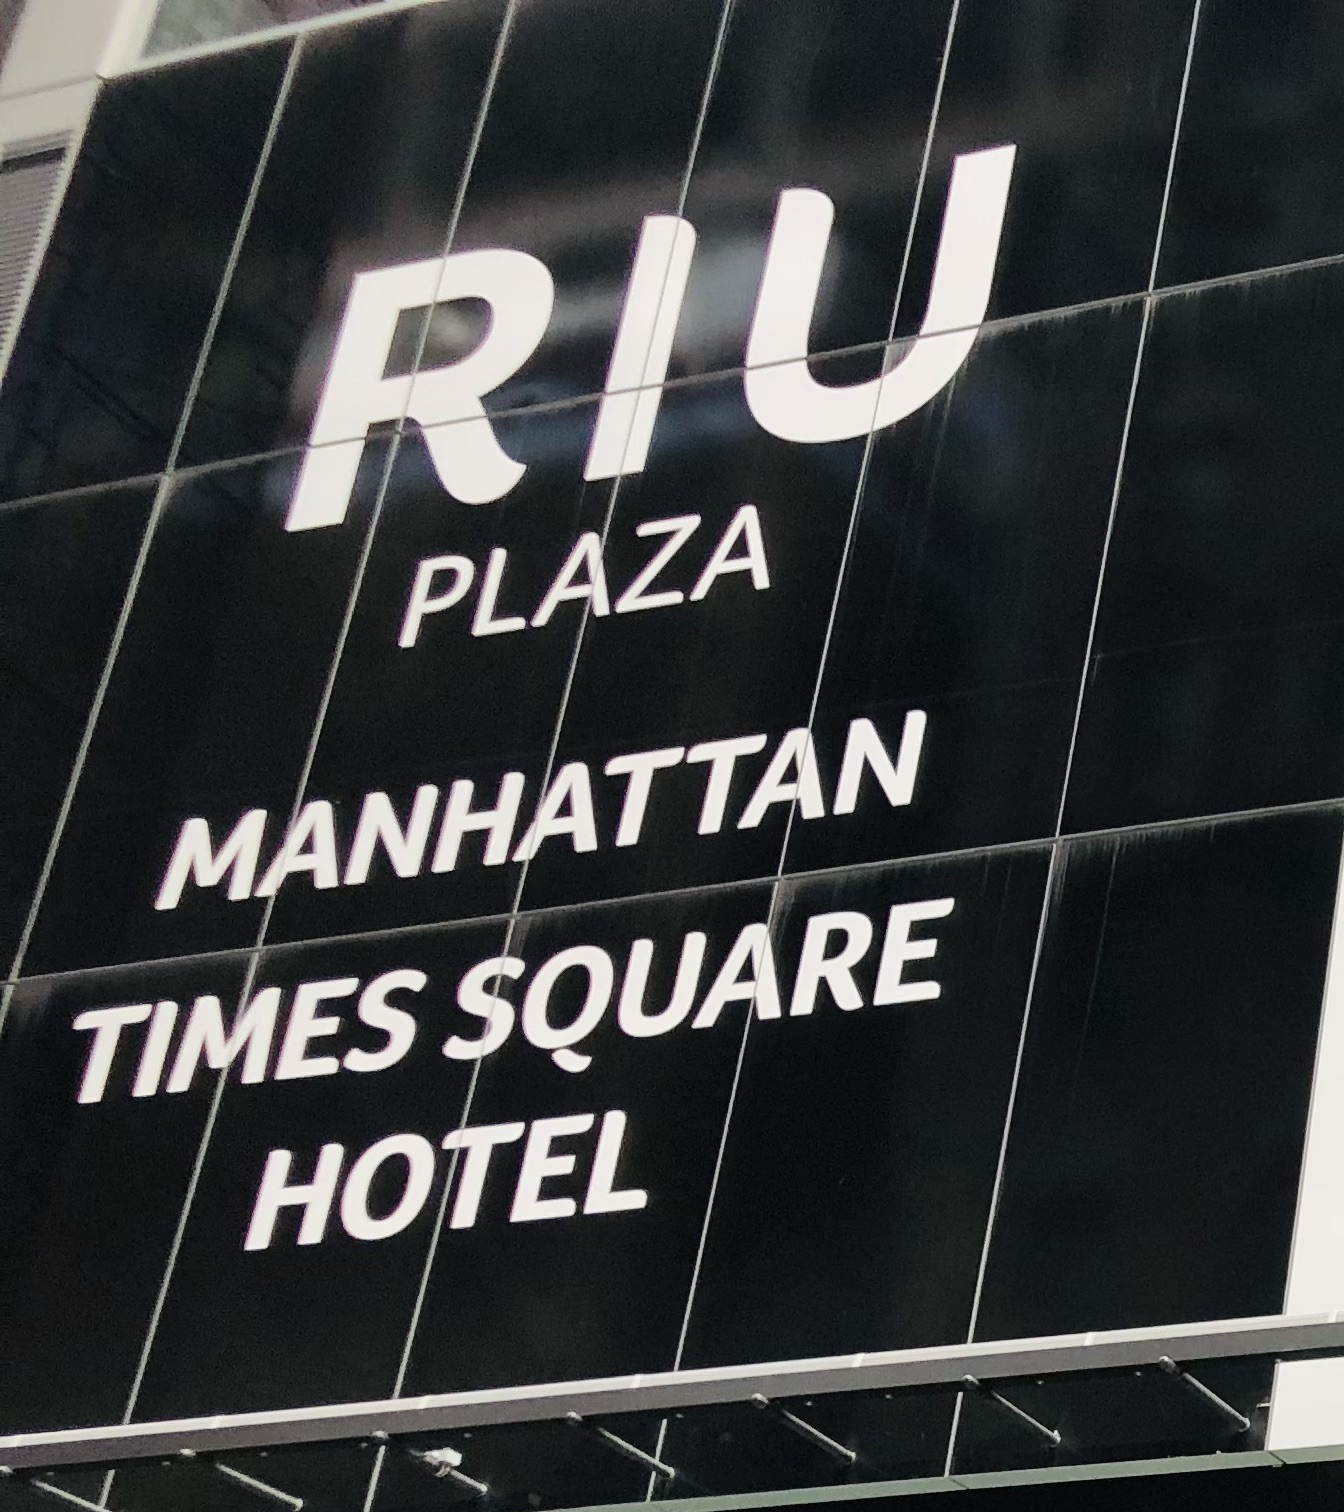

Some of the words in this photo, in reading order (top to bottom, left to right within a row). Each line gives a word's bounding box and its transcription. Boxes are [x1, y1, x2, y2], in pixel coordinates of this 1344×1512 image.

[285, 143, 1017, 533] RIU
[398, 503, 771, 649] PLAZA
[153, 709, 928, 911] MANHATTAN
[71, 969, 427, 1104] TIMES
[441, 897, 956, 1074] SQUARE
[243, 1109, 649, 1251] HOTEL
